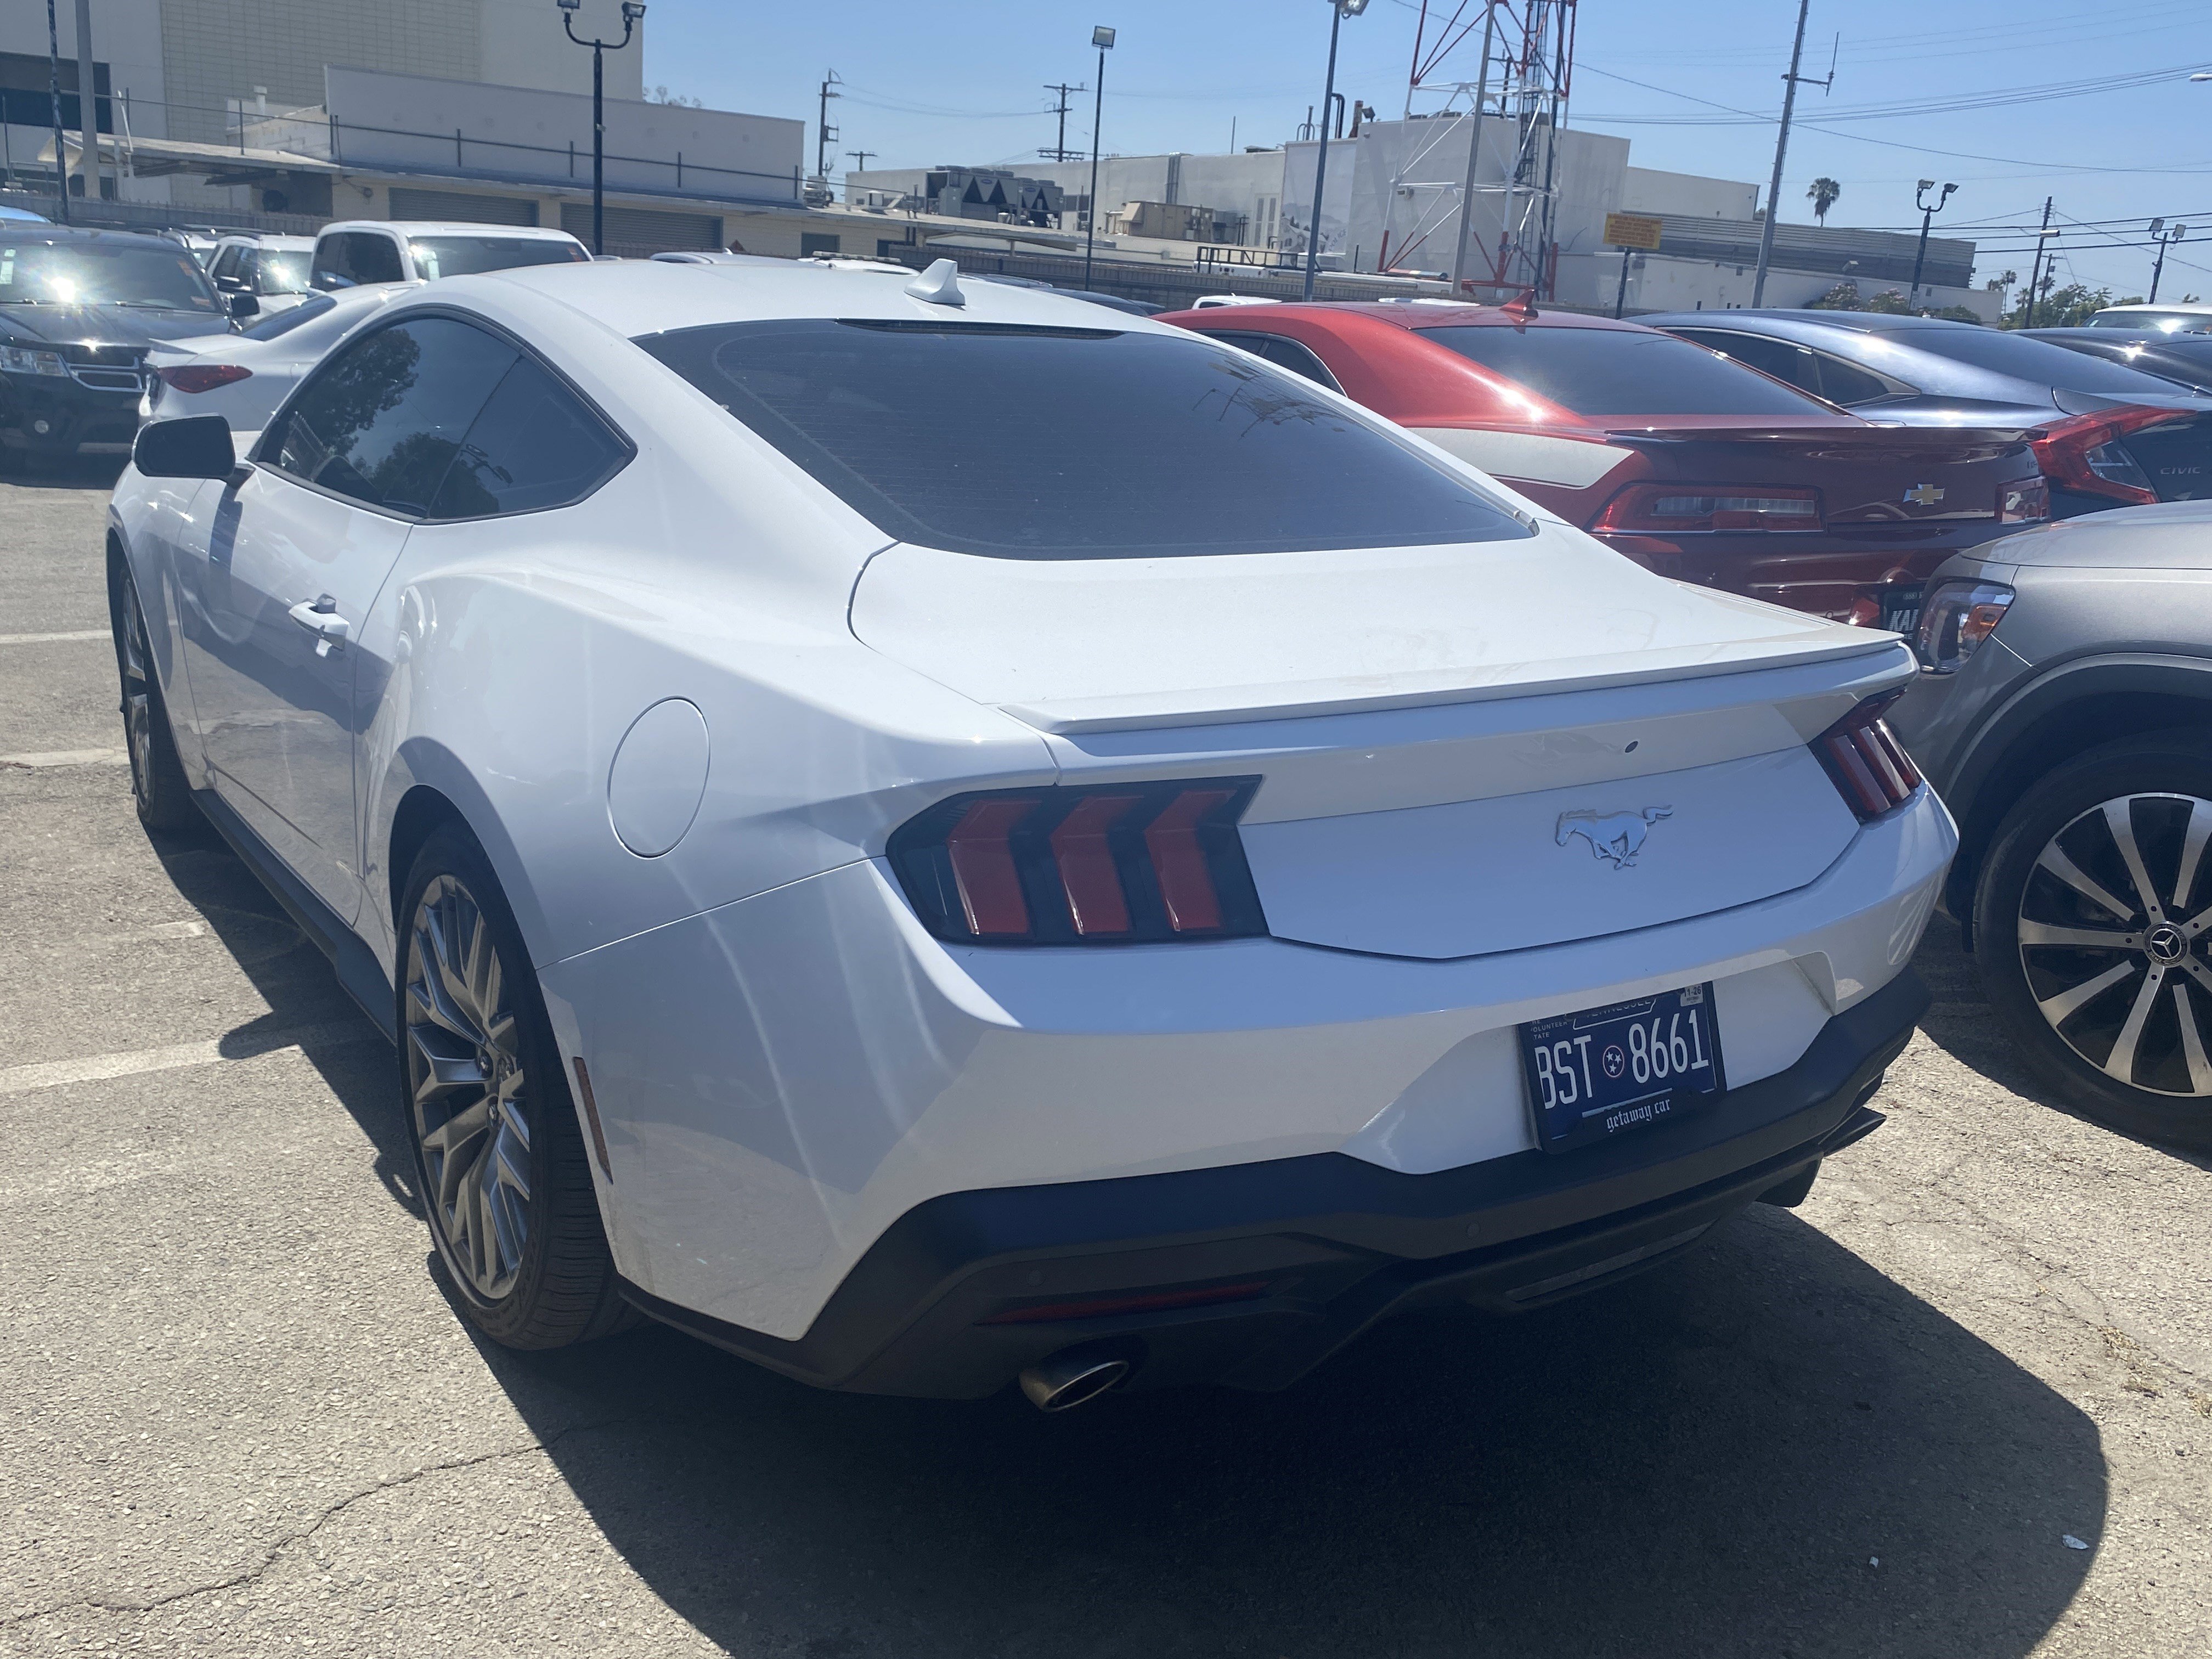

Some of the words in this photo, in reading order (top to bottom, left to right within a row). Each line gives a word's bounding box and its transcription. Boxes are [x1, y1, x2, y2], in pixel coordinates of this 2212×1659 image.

[1533, 1032, 1550, 1040] TATE
[1534, 1035, 1593, 1109] BST
[1629, 1009, 1709, 1084] 8661
[1606, 1105, 1652, 1132] getaway
[1654, 1099, 1670, 1114] car
